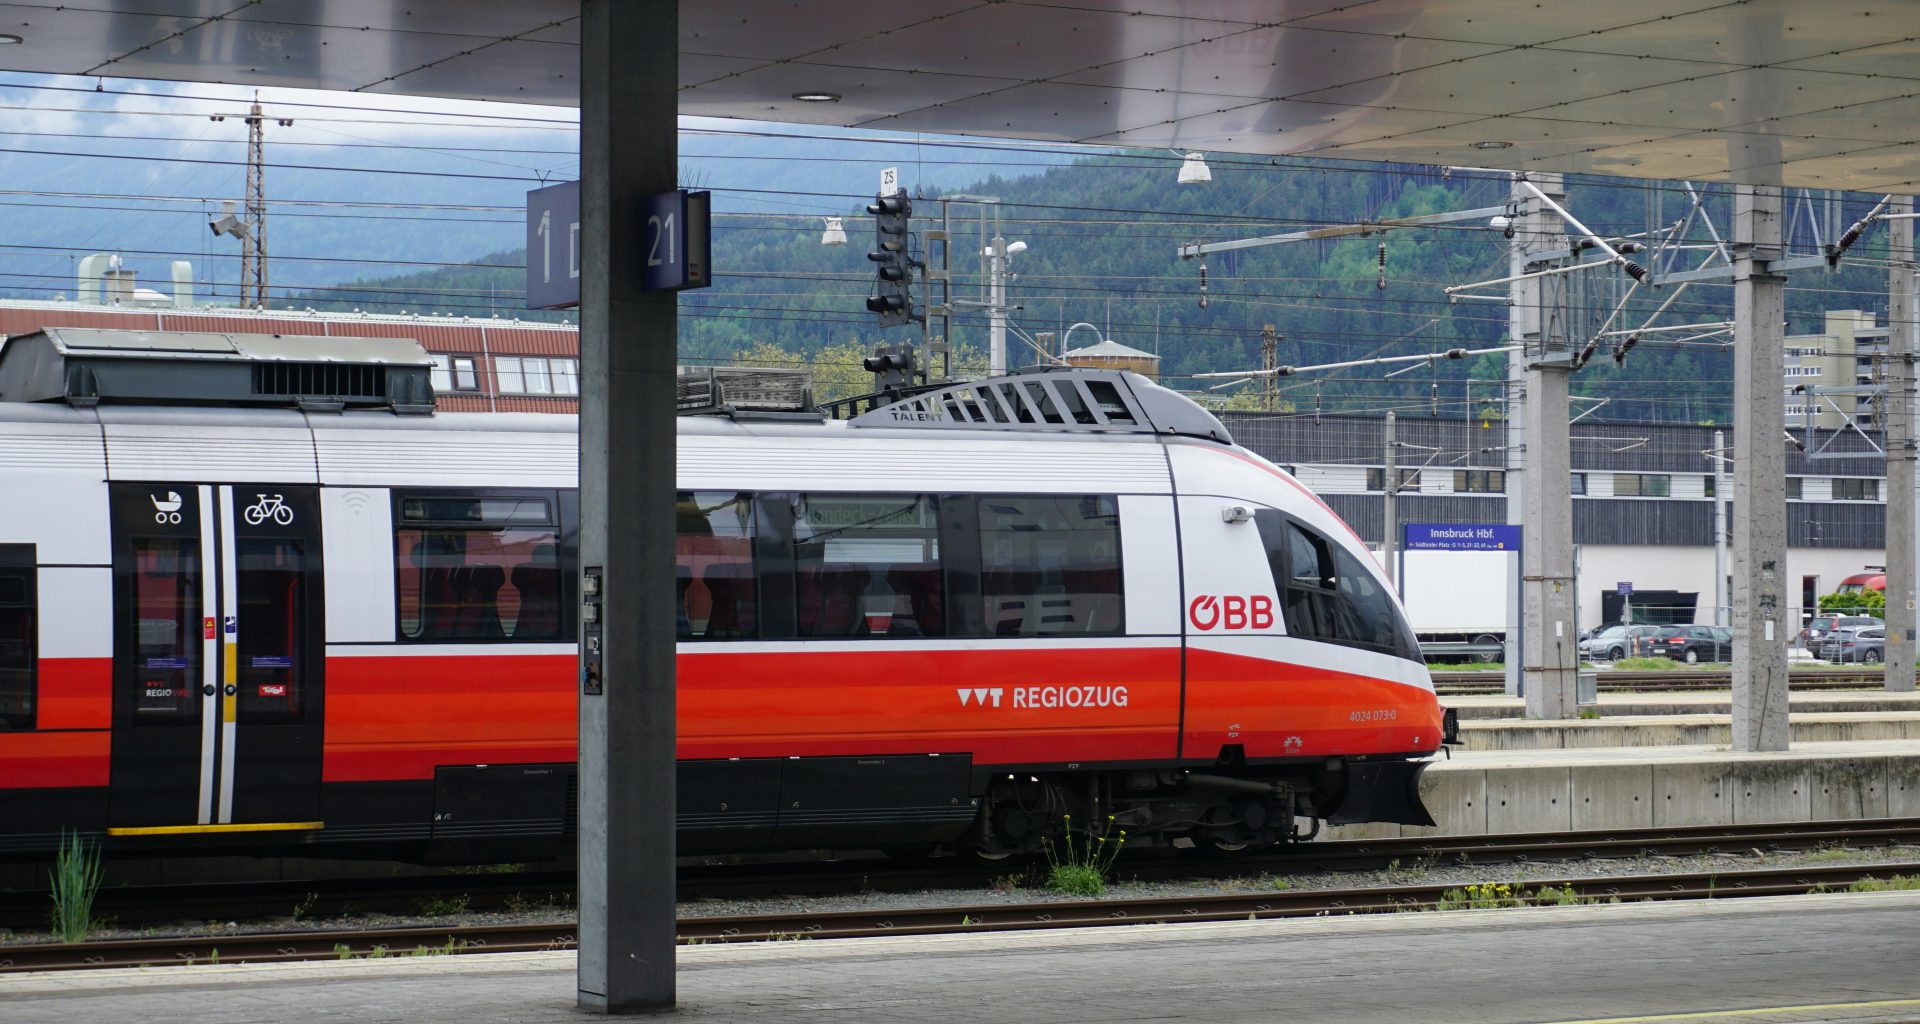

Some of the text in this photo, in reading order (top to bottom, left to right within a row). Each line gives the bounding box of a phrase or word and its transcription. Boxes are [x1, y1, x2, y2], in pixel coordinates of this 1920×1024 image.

[884, 170, 894, 184] ZS
[537, 209, 551, 283] 1
[647, 211, 675, 267] 21
[891, 412, 944, 422] TALENT
[808, 503, 916, 525] andeck-Zams
[1430, 528, 1495, 539] Innsbruck Hbf.
[1189, 594, 1274, 631] ÖBB
[957, 686, 1129, 708] VVT REGIOZUG
[1349, 711, 1371, 722] 4024
